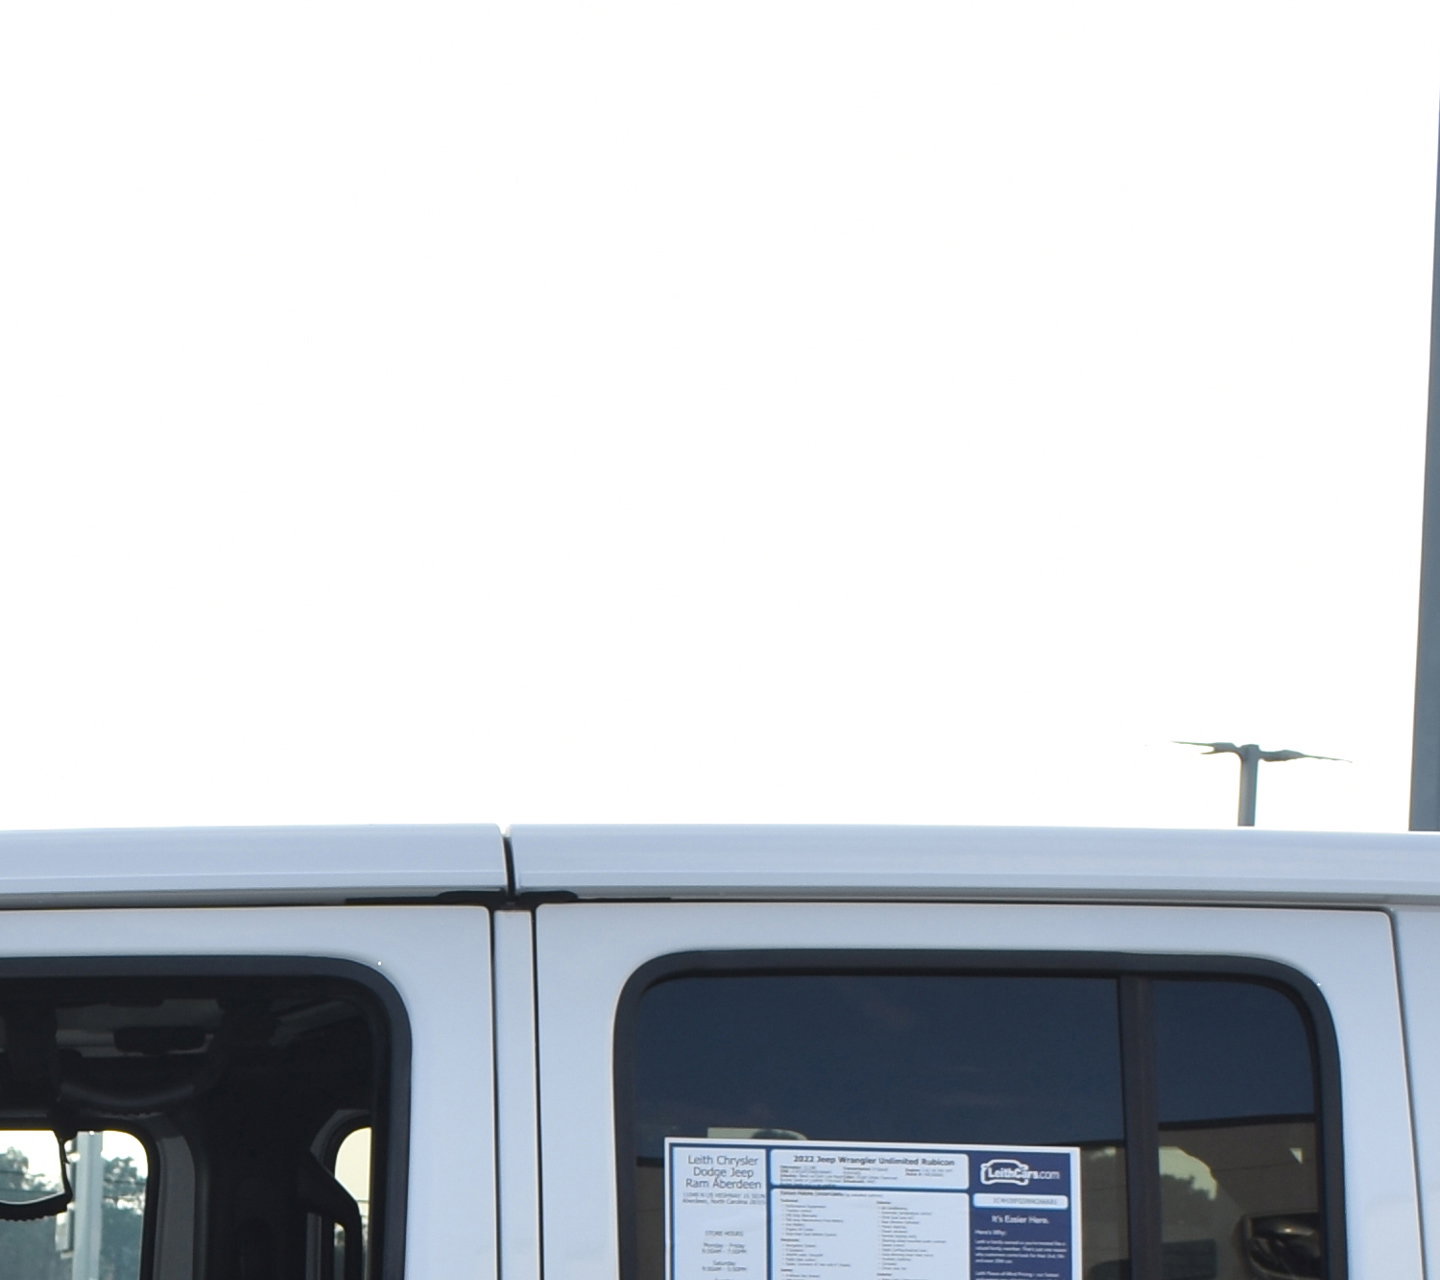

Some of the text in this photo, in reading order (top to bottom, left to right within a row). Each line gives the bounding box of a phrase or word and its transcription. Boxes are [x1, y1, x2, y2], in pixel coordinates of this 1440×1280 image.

[688, 1155, 759, 1167] Leith Chrysler
[816, 1156, 836, 1164] Jeep
[838, 1156, 877, 1166] Wrangler
[878, 1157, 919, 1166] Unlimited
[921, 1158, 955, 1166] Rubicon
[693, 1166, 754, 1179] Dodge Jeep
[987, 1166, 1061, 1180] LeithCars.com
[685, 1178, 762, 1190] Ram Aberdeen
[1004, 1215, 1027, 1224] Easier
